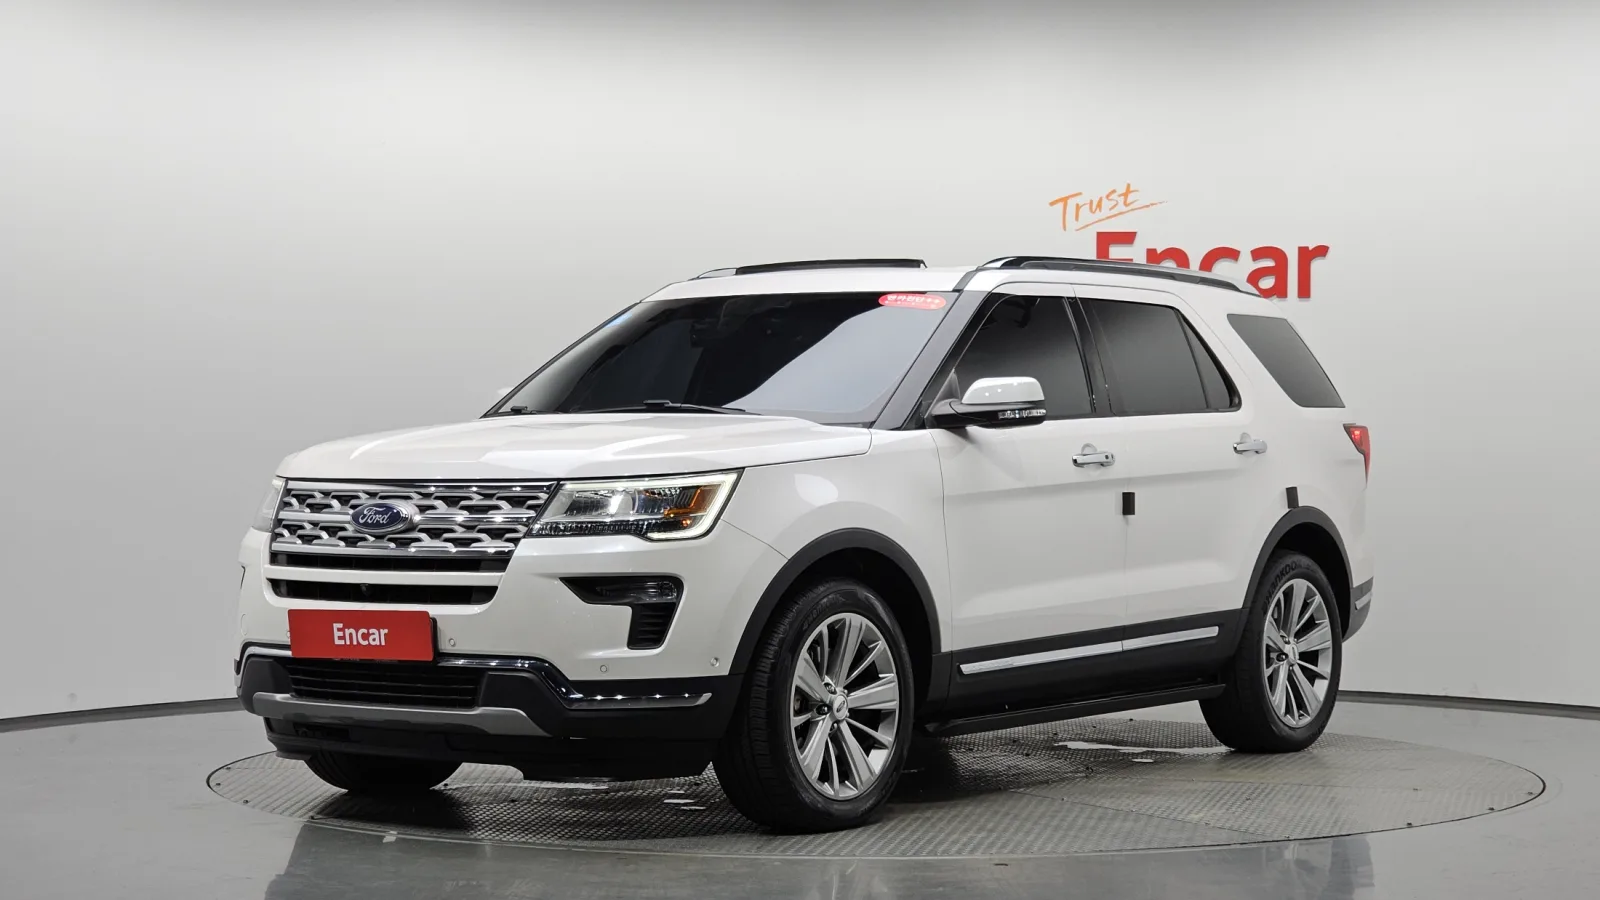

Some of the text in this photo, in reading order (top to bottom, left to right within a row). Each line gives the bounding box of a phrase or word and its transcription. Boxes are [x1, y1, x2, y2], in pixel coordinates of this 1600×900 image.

[1048, 182, 1140, 231] Trust
[358, 506, 392, 524] Ford
[332, 622, 389, 646] Encar
